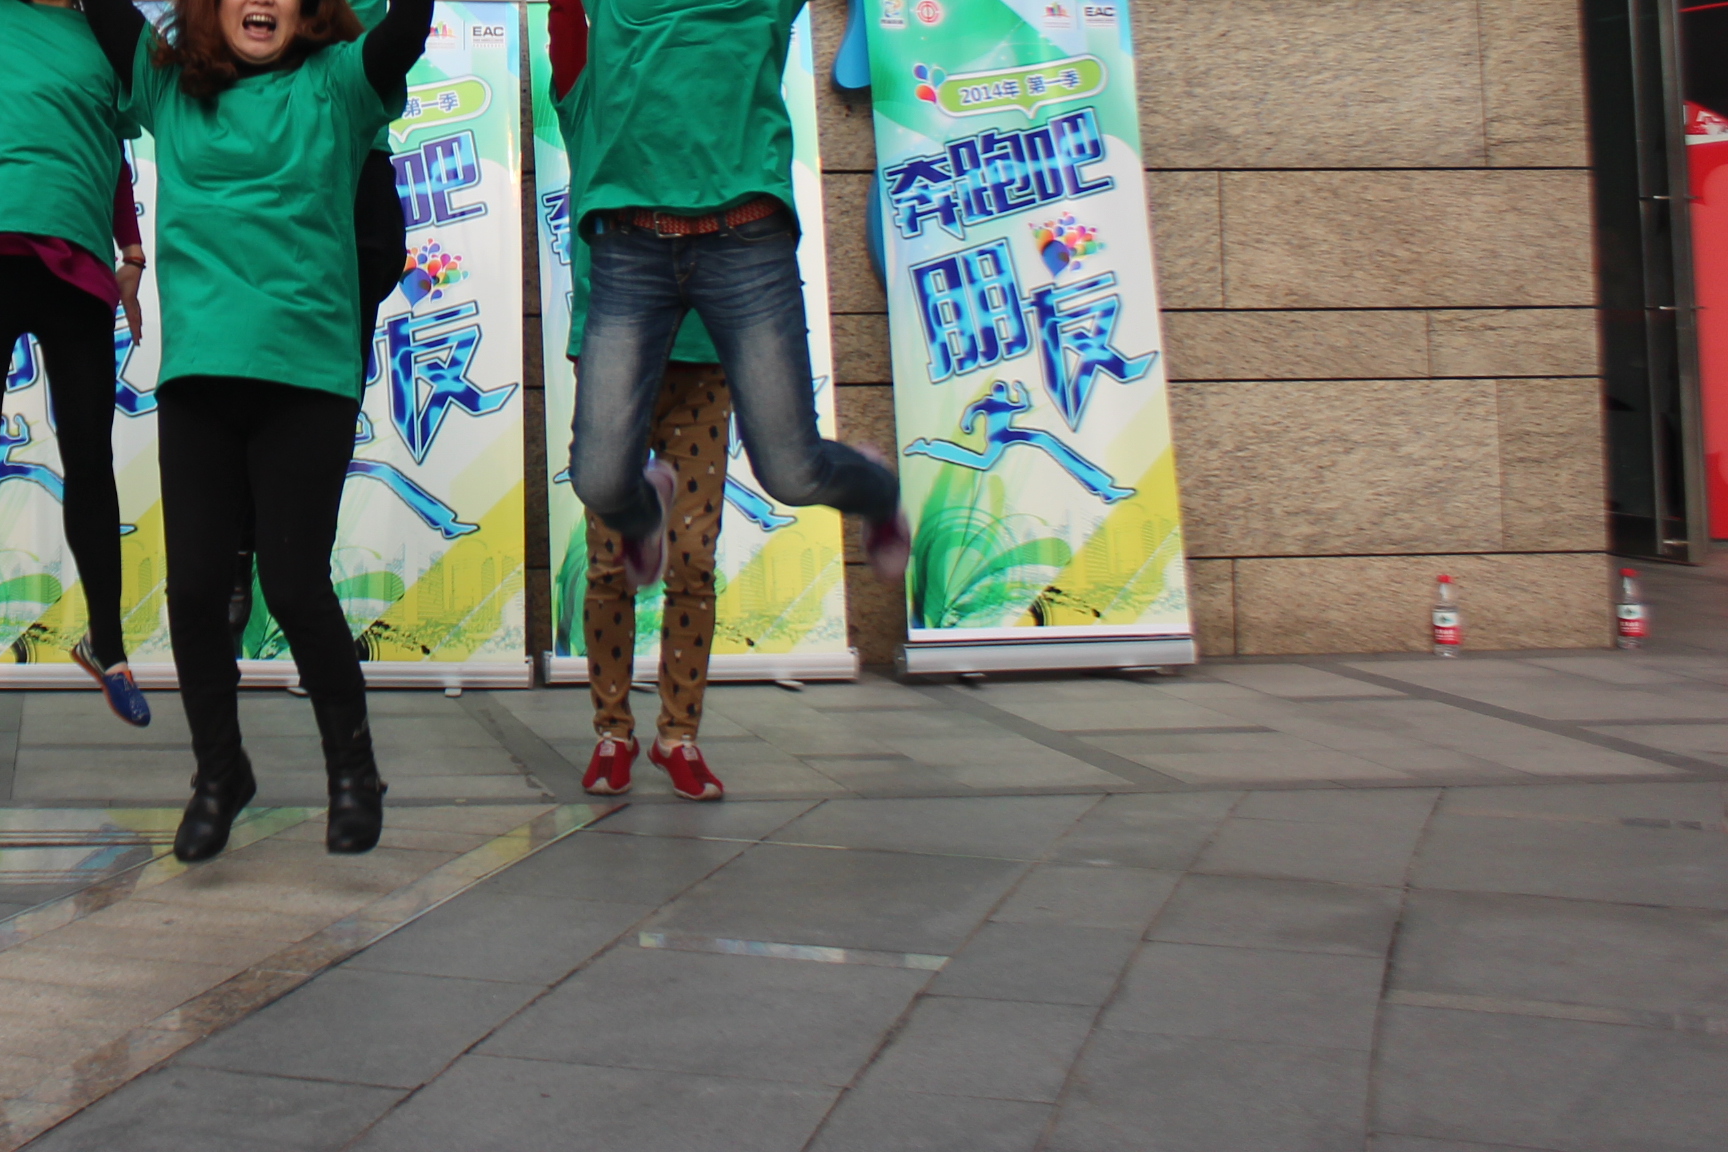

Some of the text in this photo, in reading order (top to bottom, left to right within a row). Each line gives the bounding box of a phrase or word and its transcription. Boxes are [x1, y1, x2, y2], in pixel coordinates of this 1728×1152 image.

[1084, 5, 1116, 18] EAC
[472, 26, 505, 37] EAC
[958, 68, 1081, 105] 2014年 第一季
[404, 91, 459, 119] 第一季
[883, 105, 1114, 241] 奔跑吧
[908, 236, 1160, 434] 朋友
